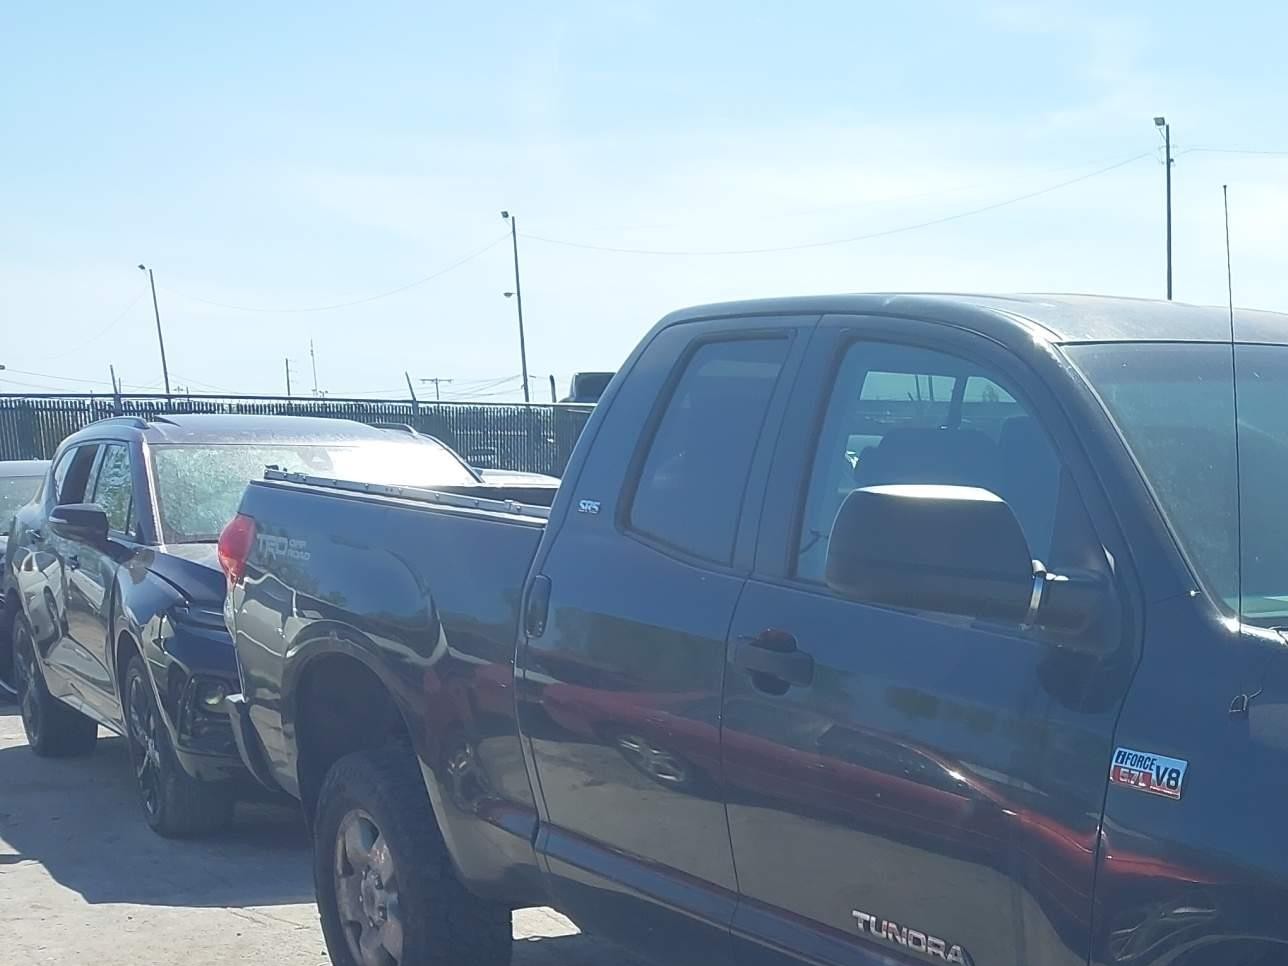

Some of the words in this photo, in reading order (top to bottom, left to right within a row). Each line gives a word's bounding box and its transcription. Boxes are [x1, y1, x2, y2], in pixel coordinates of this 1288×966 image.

[257, 533, 288, 560] TRD
[1119, 768, 1147, 787] 5.7L
[1155, 765, 1181, 790] V8
